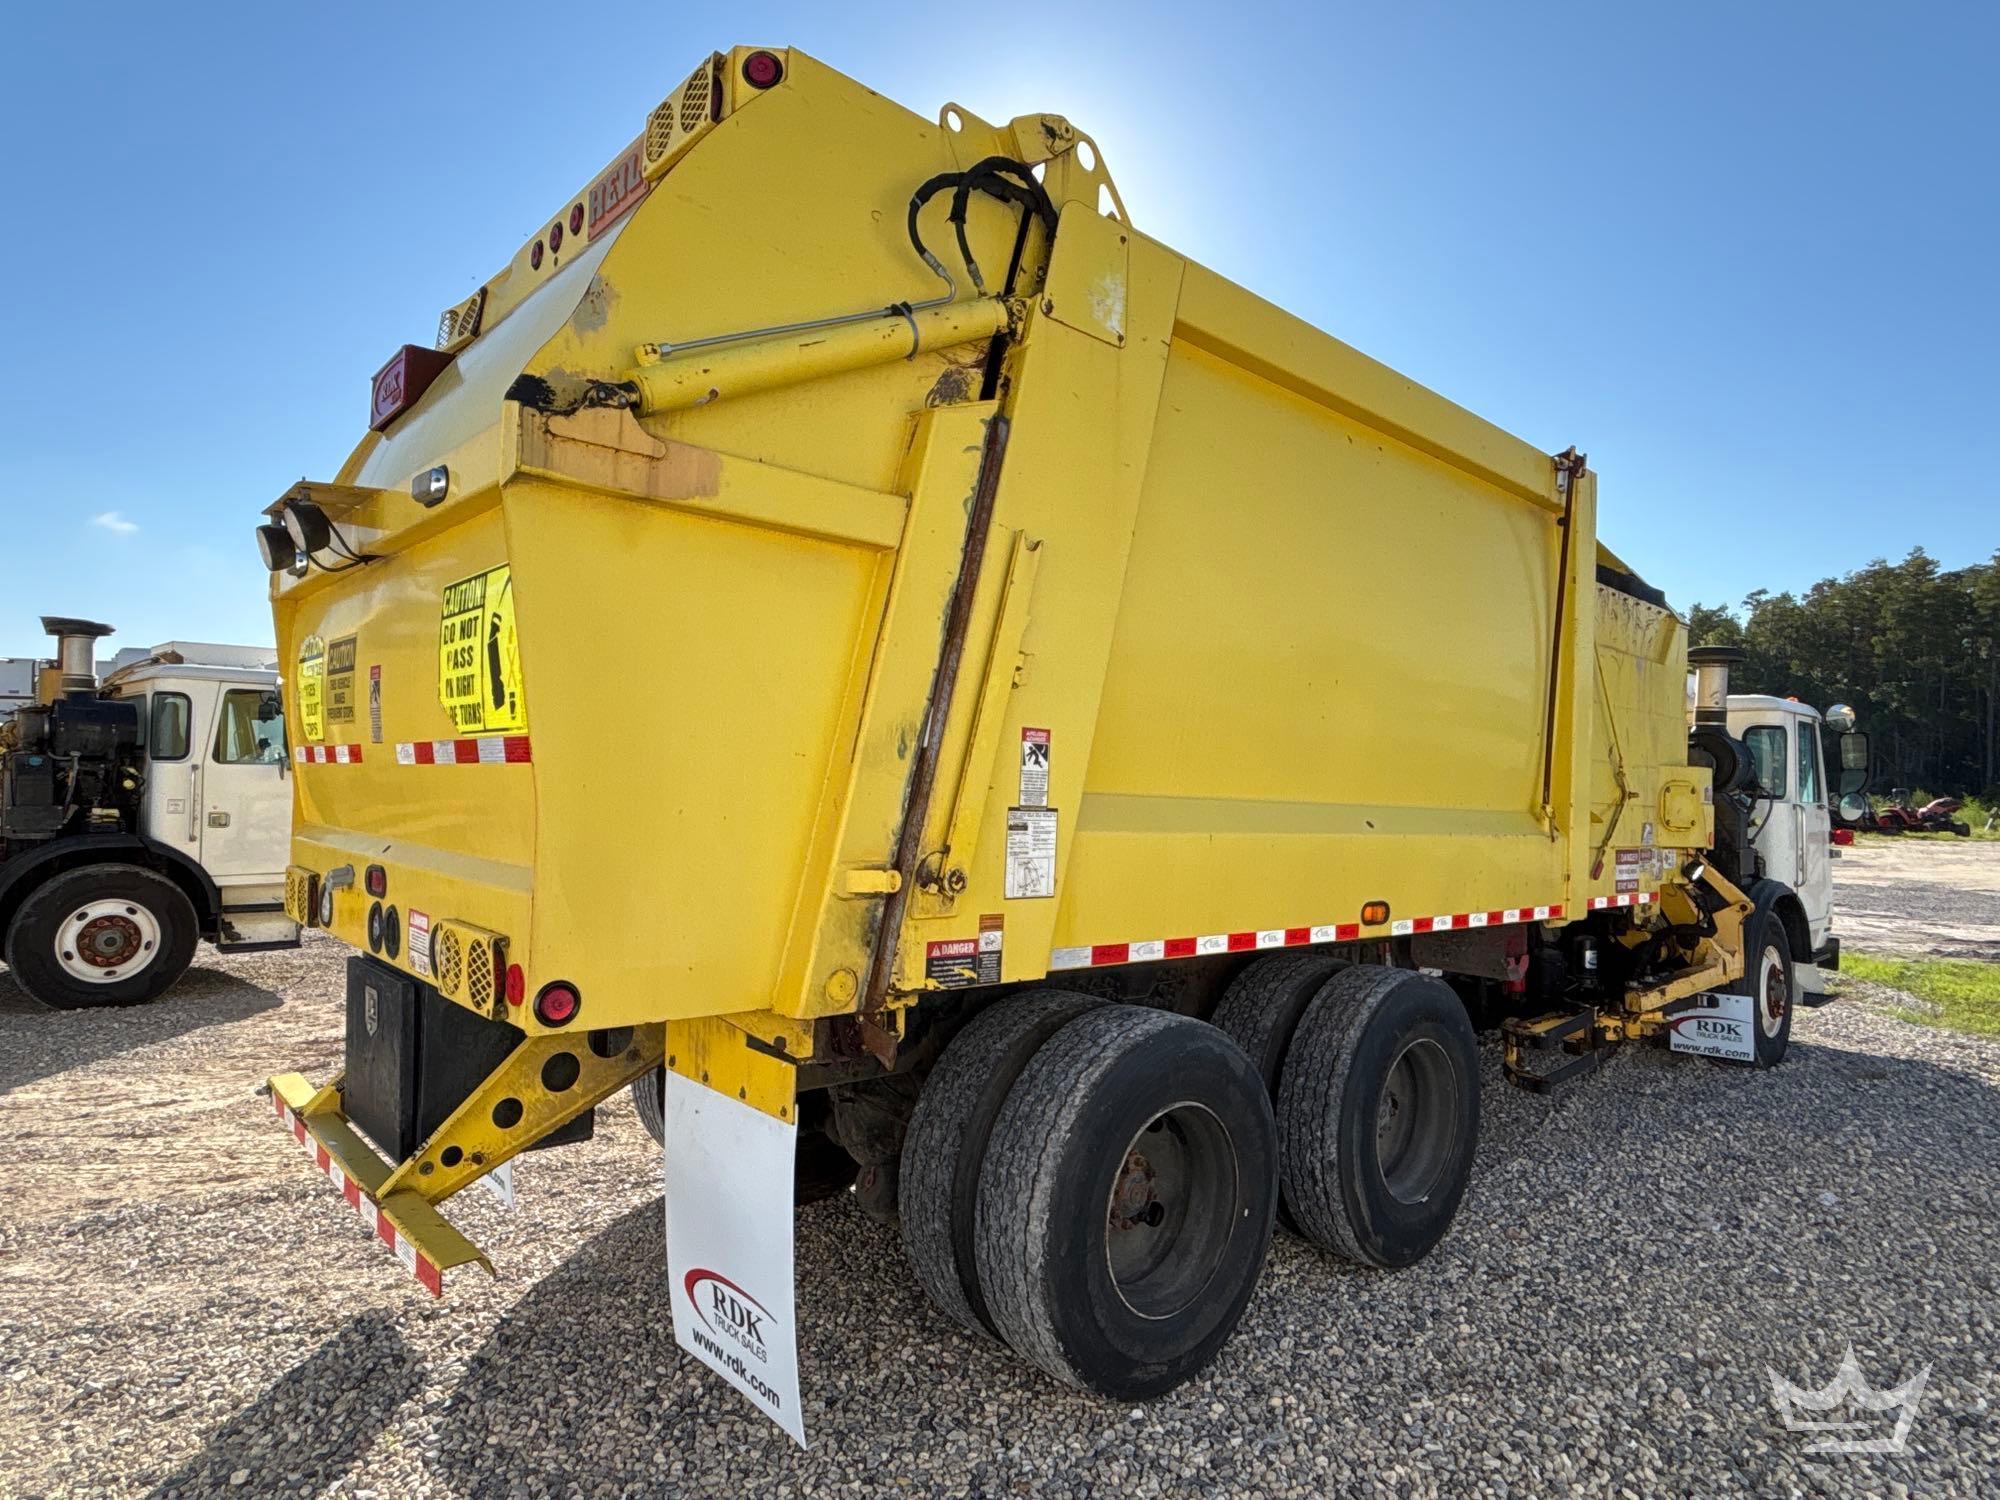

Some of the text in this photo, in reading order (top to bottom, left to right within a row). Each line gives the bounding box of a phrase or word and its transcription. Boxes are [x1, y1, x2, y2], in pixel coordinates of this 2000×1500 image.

[443, 576, 486, 617] CAUTION!
[443, 615, 479, 645] DO NOT
[447, 645, 474, 672] PASS
[456, 673, 475, 698] RIGHT
[941, 942, 975, 955] DANGER
[1696, 1020, 1742, 1036] RDK
[1696, 1030, 1744, 1043] TRUCK SALES
[1673, 1042, 1751, 1059] www.rdk.com
[711, 1282, 766, 1347] RDK
[714, 1312, 768, 1364] TRUCK SALES
[692, 1327, 781, 1409] www.rdk.com
